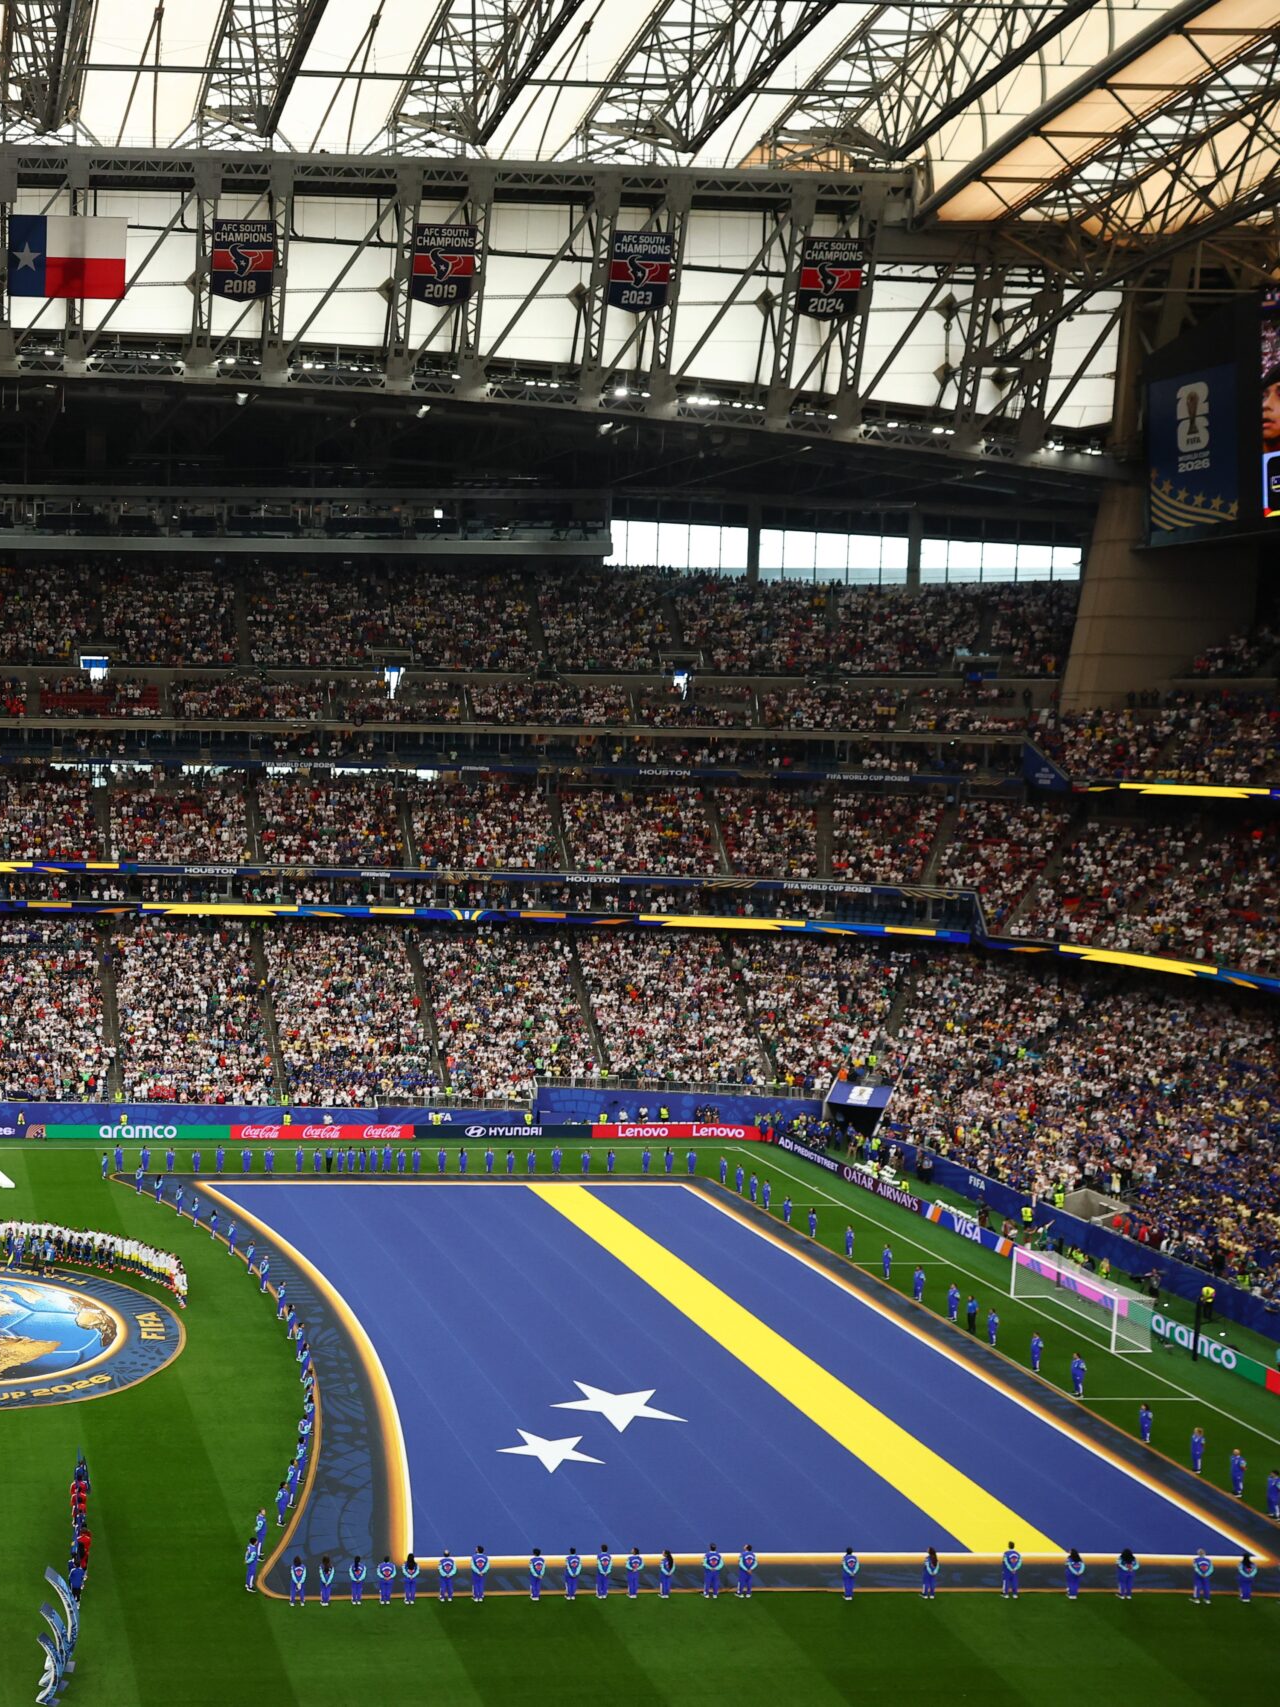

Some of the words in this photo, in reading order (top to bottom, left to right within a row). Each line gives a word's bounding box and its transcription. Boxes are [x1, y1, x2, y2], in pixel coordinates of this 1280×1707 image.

[239, 224, 267, 232] SOUTH
[424, 228, 440, 236] AFC
[441, 228, 469, 237] SOUTH
[214, 232, 273, 243] CHAMPIONS
[416, 236, 474, 247] CHAMPIONS
[621, 235, 638, 243] AFC
[639, 235, 666, 244] SOUTH
[615, 243, 670, 255] CHAMPIONS
[813, 242, 829, 250] AFC
[830, 242, 858, 251] SOUTH
[805, 250, 863, 262] CHAMPIONS
[224, 279, 256, 294] 2018
[424, 284, 457, 299] 2019
[621, 290, 653, 305] 2023
[808, 298, 844, 313] 2024
[1186, 437, 1201, 446] FIFA
[844, 885, 872, 893] 2026
[428, 1112, 452, 1121] FFA
[99, 1124, 177, 1139] aramco
[241, 1125, 280, 1139] Coca-Cola
[302, 1125, 340, 1139] Coca-Cola
[363, 1125, 402, 1139] Coca-Cola
[489, 1126, 542, 1136] HYUNDAI
[618, 1125, 669, 1137] Lenovo
[692, 1125, 745, 1138] Lenovo
[794, 1144, 839, 1172] PREDICTSTREET
[843, 1167, 874, 1190] QATAR
[877, 1183, 919, 1212] AIRWAYS
[969, 1175, 986, 1190] FIFA
[952, 1214, 982, 1244] VISA
[134, 1312, 166, 1341] FIFA
[1152, 1314, 1237, 1370] aramco
[30, 1374, 112, 1398] 2026
